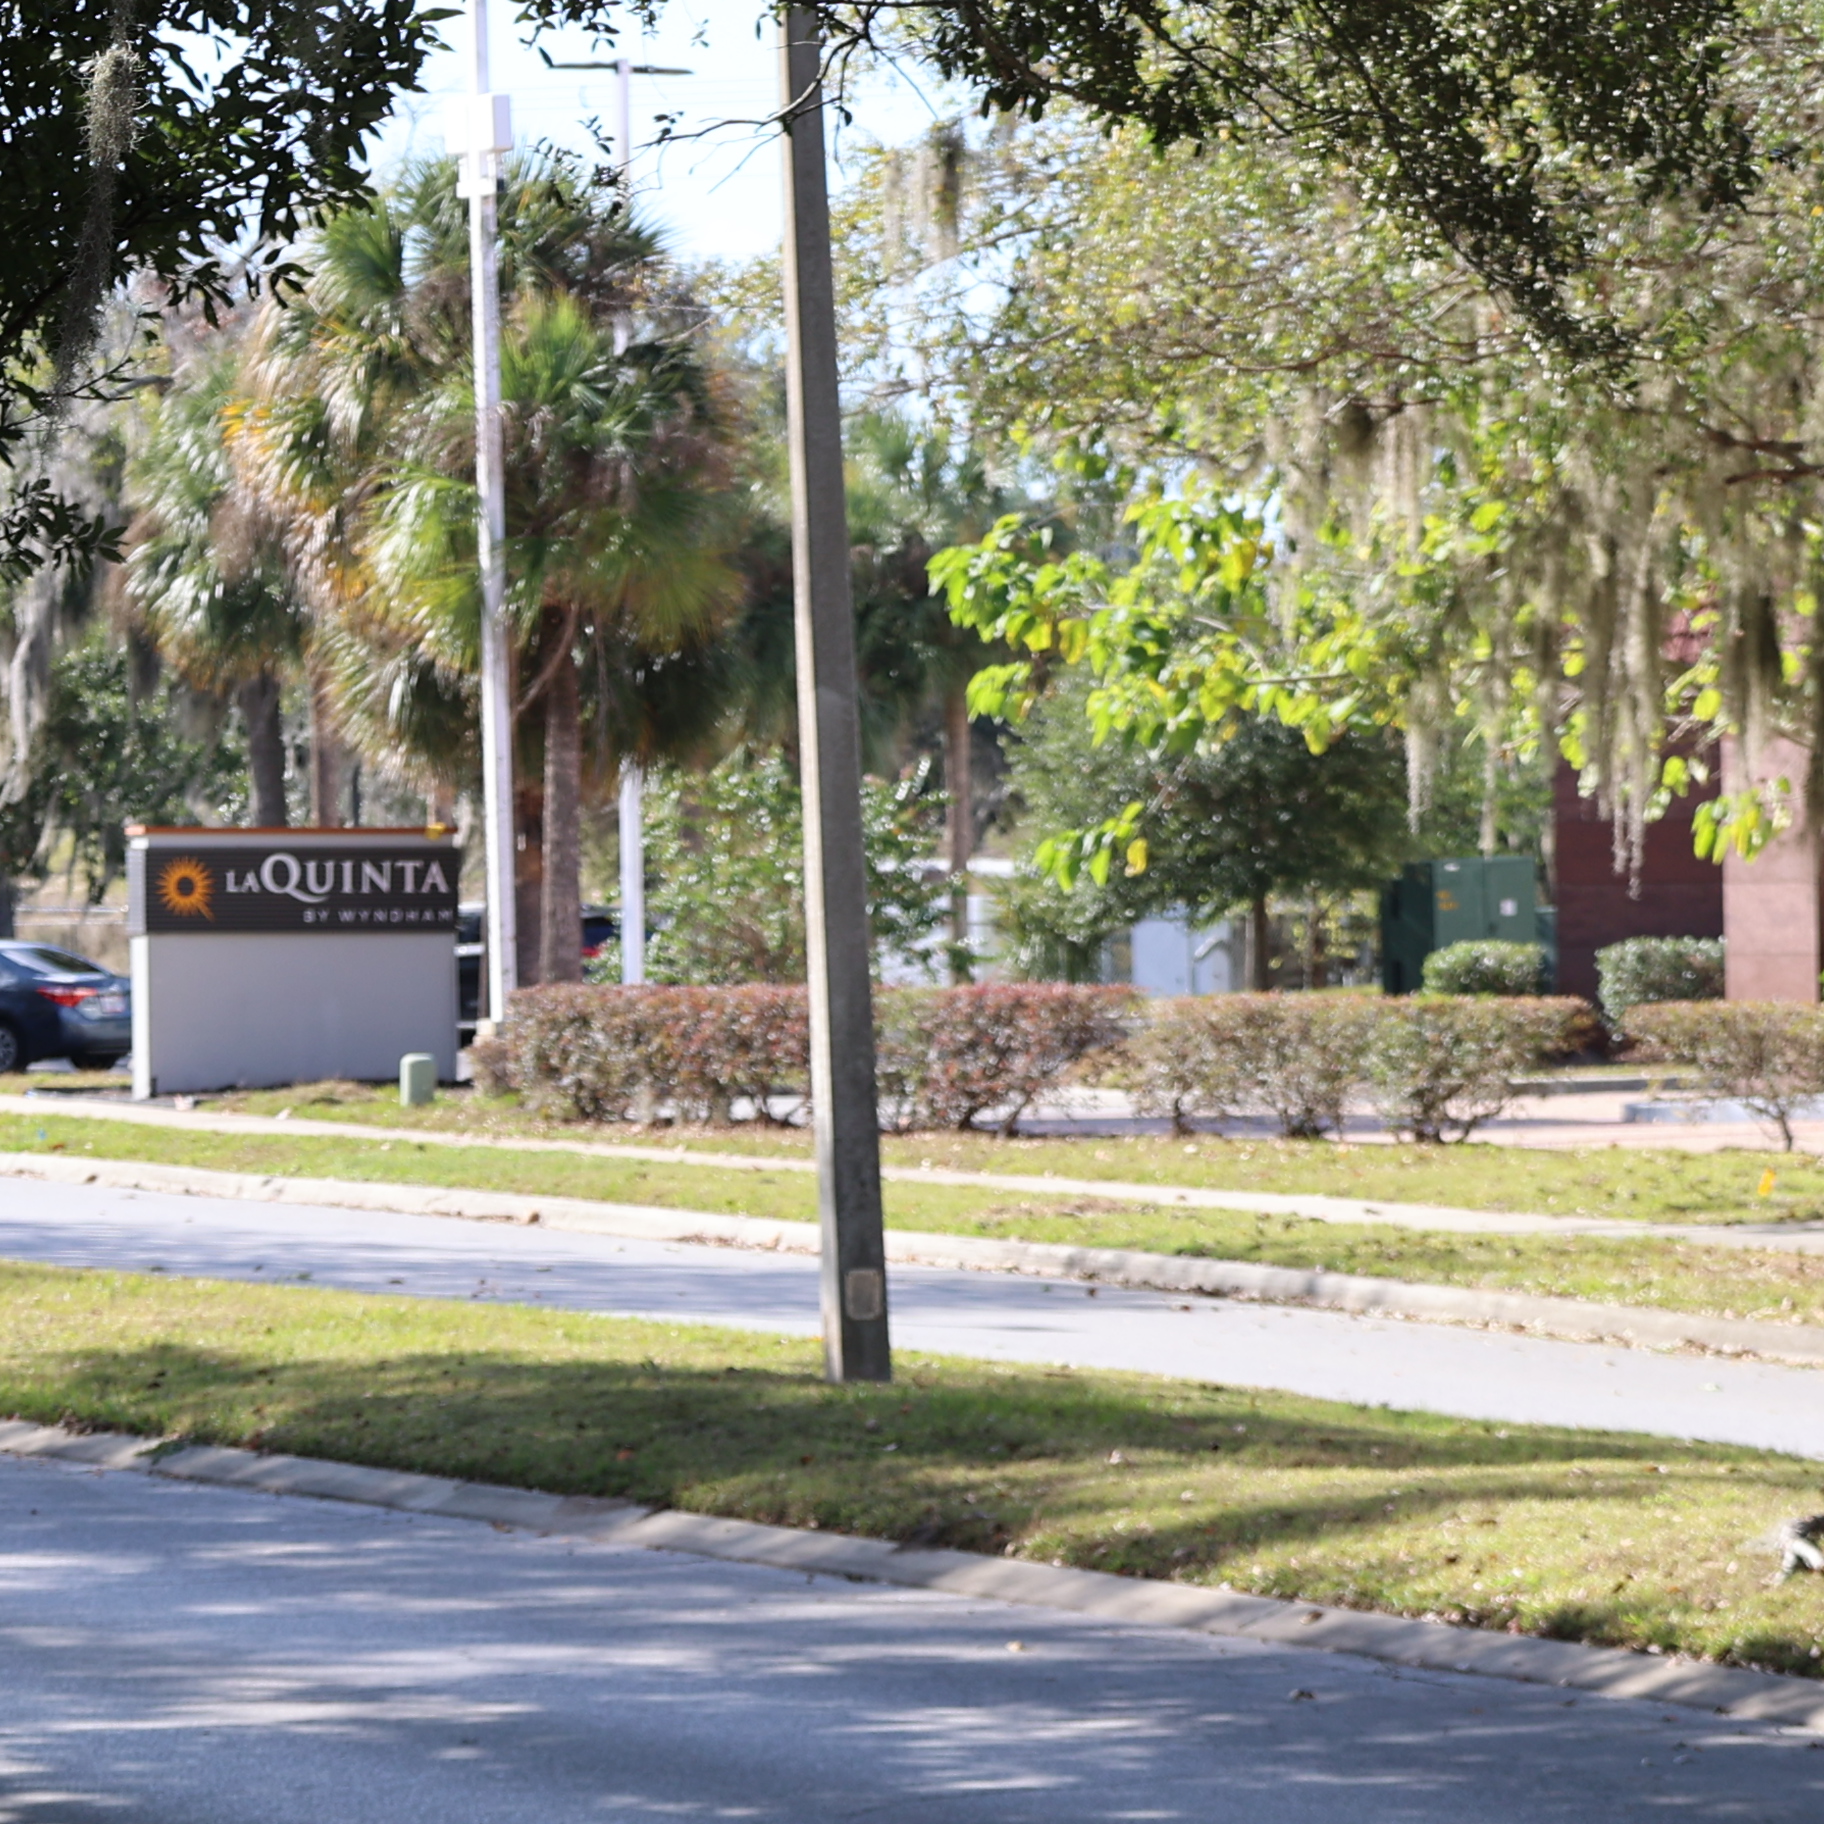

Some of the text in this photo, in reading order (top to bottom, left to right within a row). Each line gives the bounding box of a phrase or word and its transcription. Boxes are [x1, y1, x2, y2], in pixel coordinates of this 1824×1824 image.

[260, 852, 450, 903] QUINTA
[302, 908, 454, 923] BY WYNDHAM
